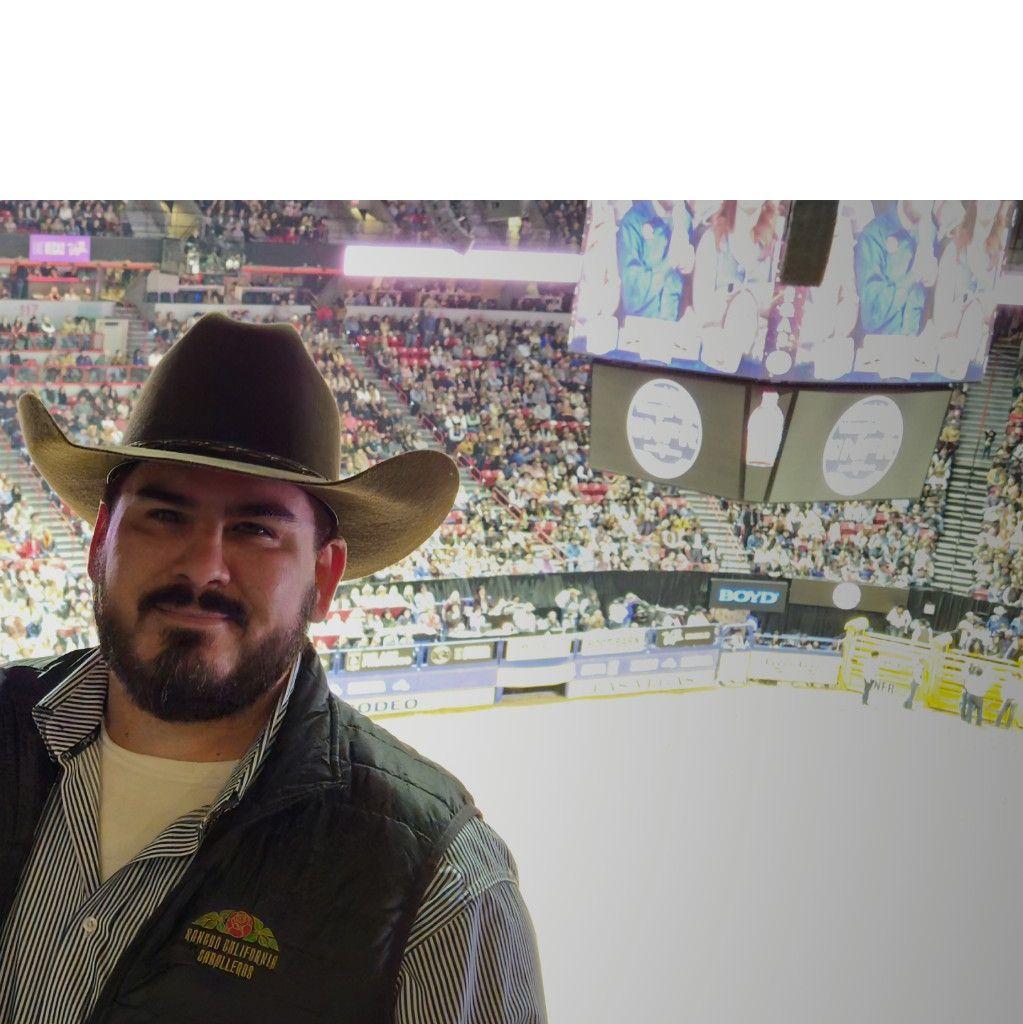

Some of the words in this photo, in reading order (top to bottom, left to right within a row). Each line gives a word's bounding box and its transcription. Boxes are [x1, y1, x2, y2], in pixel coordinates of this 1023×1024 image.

[718, 588, 778, 604] BOYD
[358, 699, 418, 713] ODEO
[184, 927, 221, 951] RANCHO
[222, 938, 278, 969] CALIFORNIA
